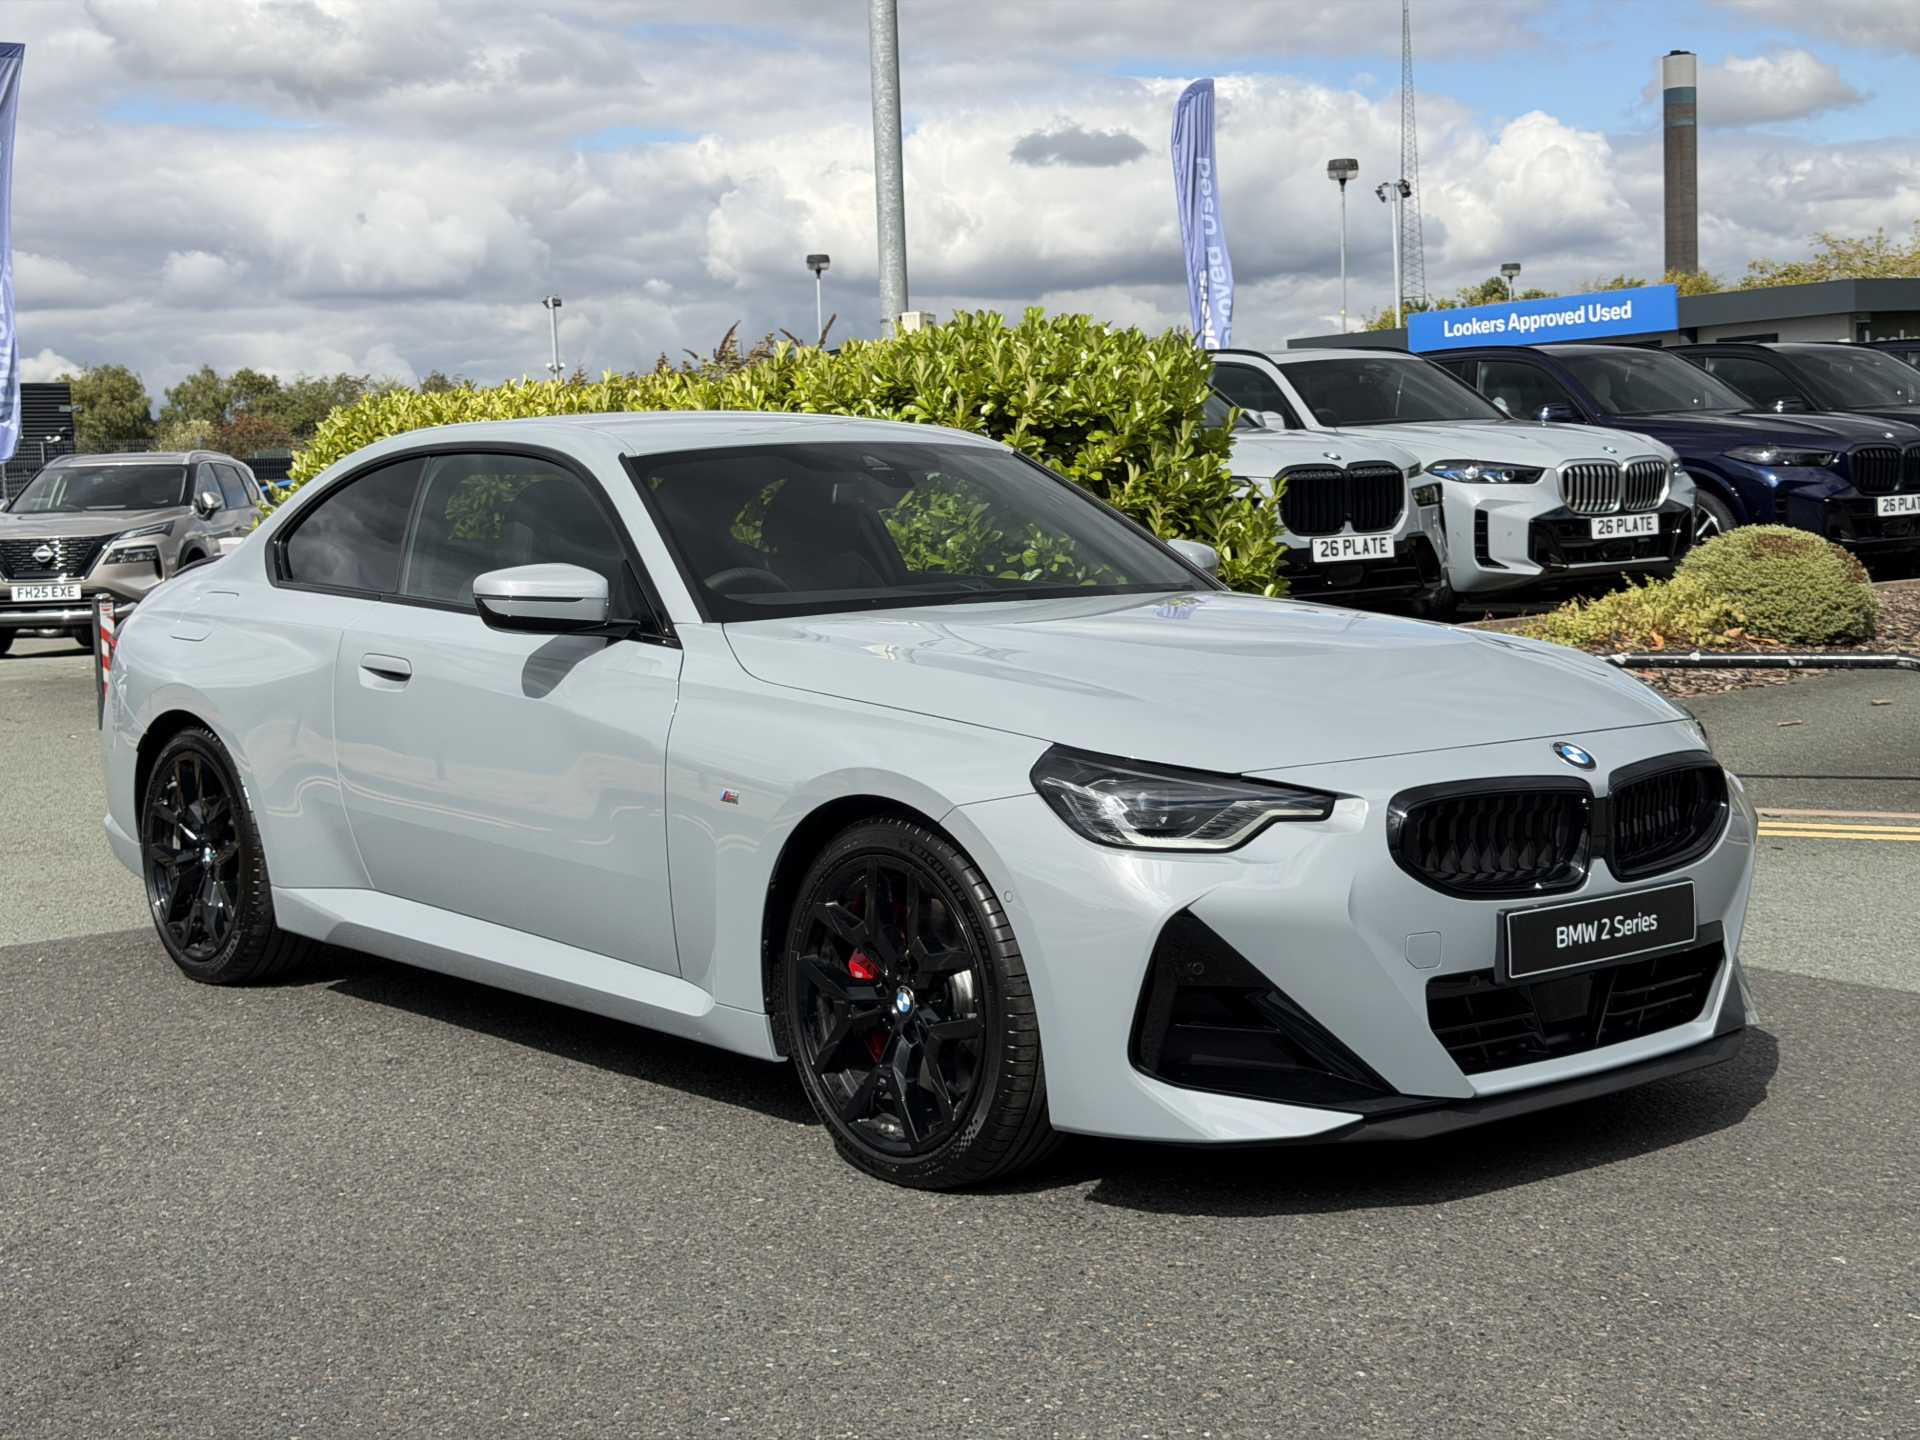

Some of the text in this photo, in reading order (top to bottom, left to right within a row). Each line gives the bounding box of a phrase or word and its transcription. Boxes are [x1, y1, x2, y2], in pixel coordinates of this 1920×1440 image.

[1197, 158, 1217, 236] Used
[1444, 300, 1632, 337] Lookers Approved Used
[1883, 498, 1896, 512] 26
[1598, 516, 1653, 535] 26 PLATE
[1320, 537, 1388, 557] 26 PLATE
[17, 586, 75, 599] FH25 EXE
[1556, 911, 1658, 949] BMW 2 Series
